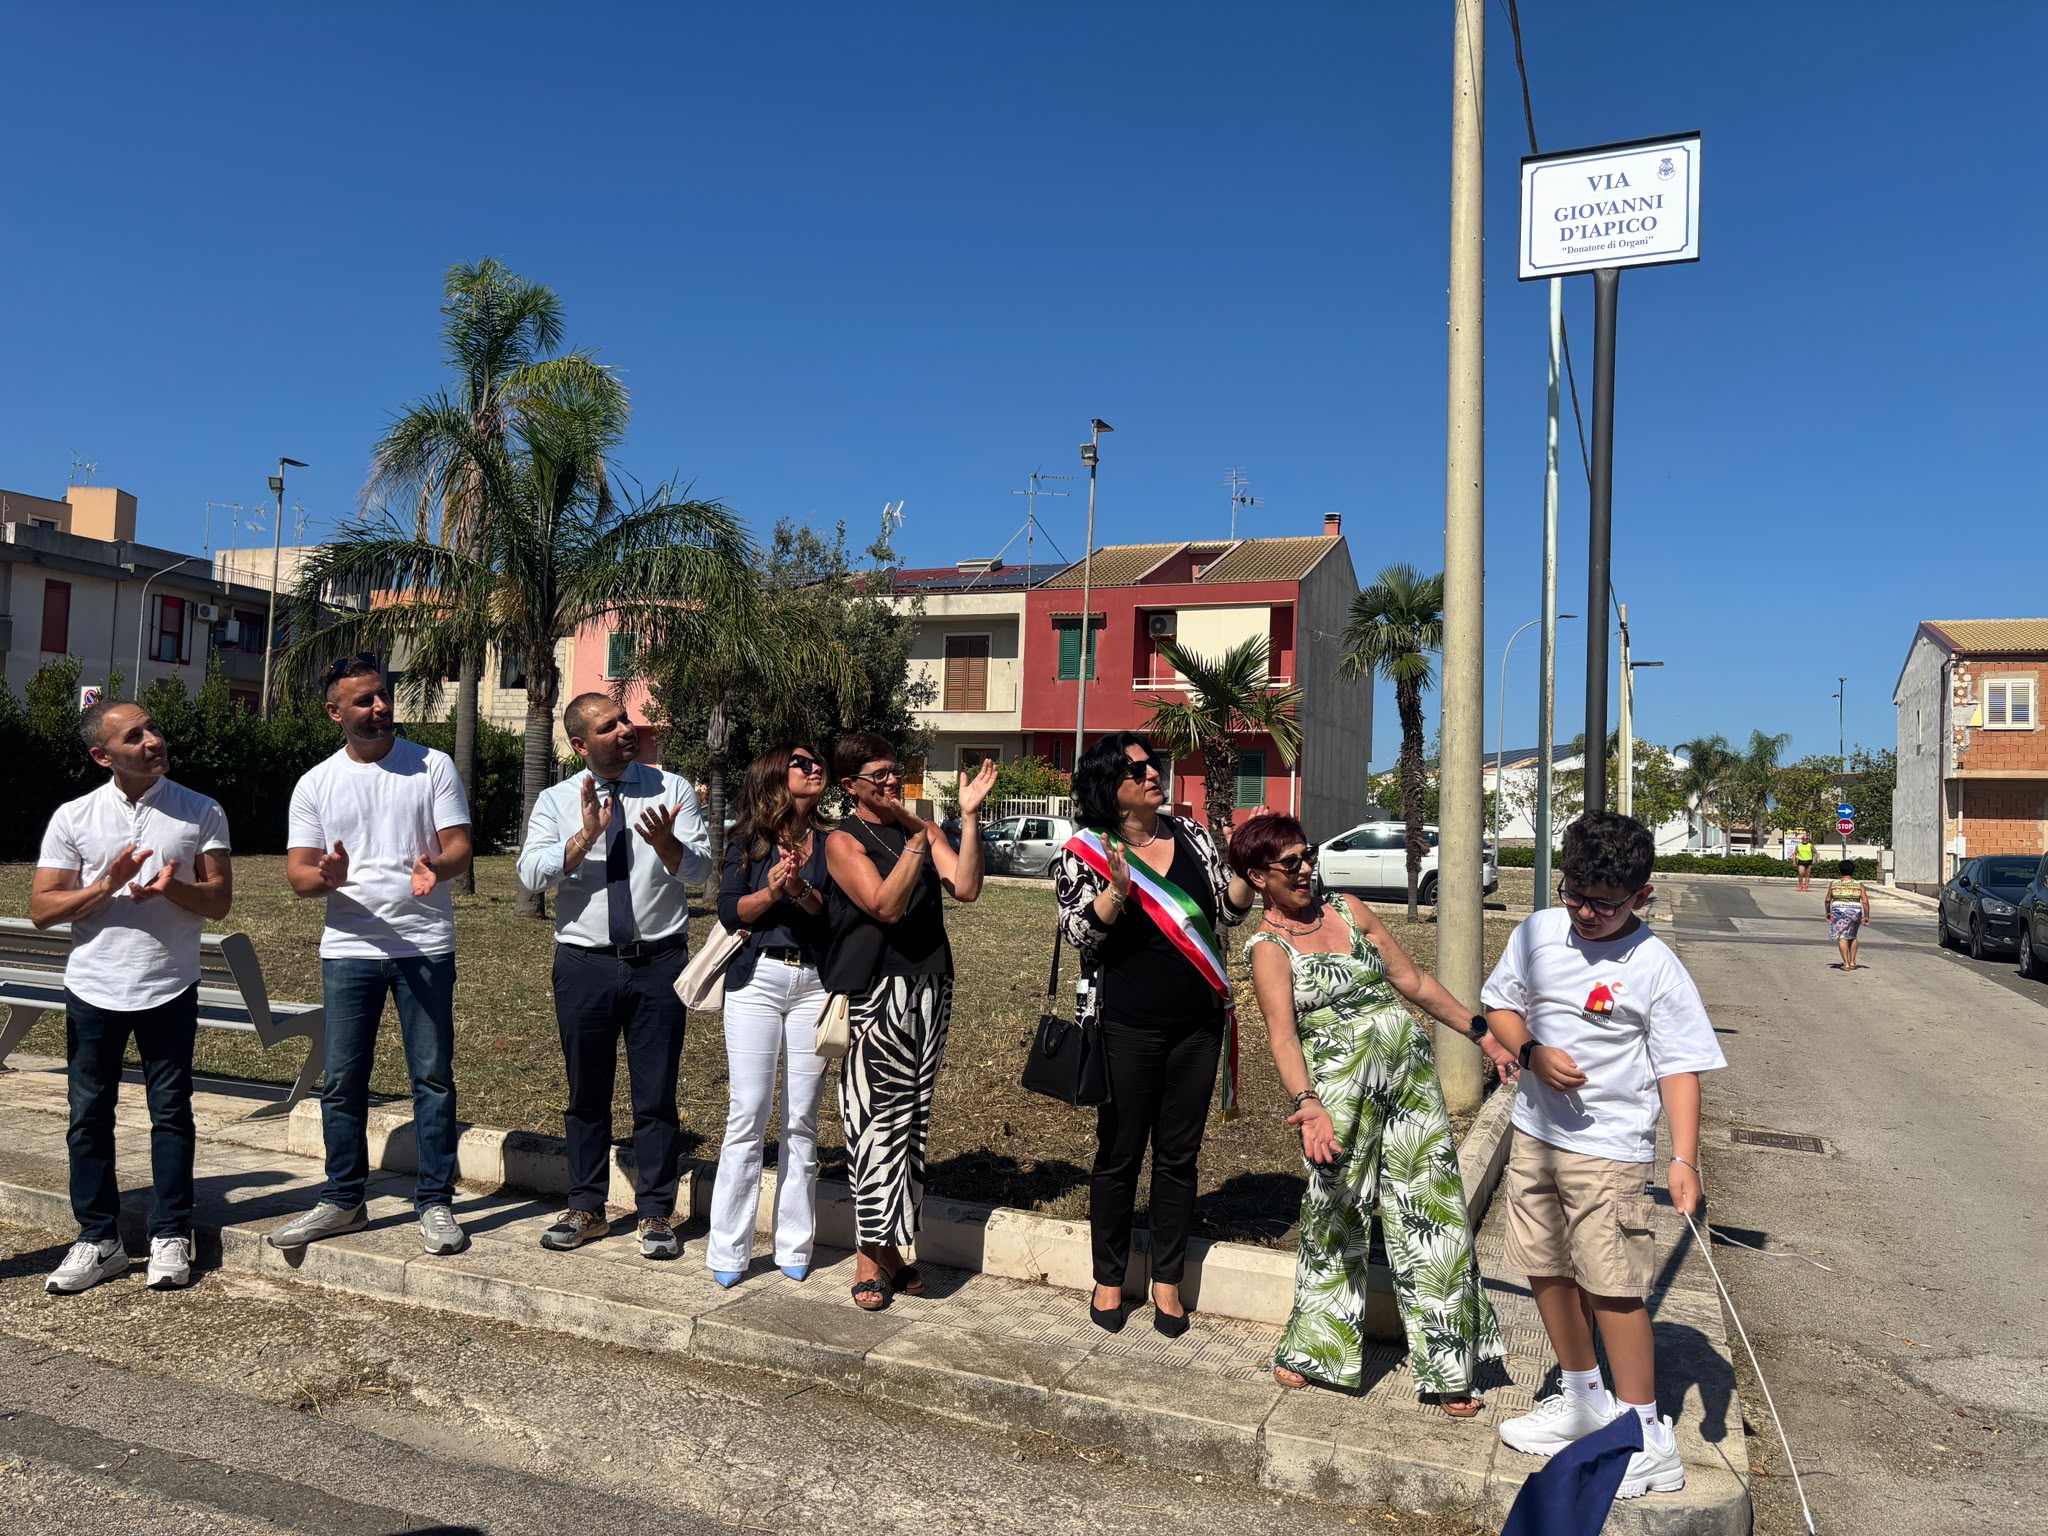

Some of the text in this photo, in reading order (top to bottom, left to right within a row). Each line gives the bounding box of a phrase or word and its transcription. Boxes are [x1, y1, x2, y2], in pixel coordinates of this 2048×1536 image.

[1587, 172, 1631, 192] VIA
[1554, 194, 1664, 222] GIOVANNI
[1559, 216, 1658, 242] D’IAPICO
[1607, 240, 1616, 249] di
